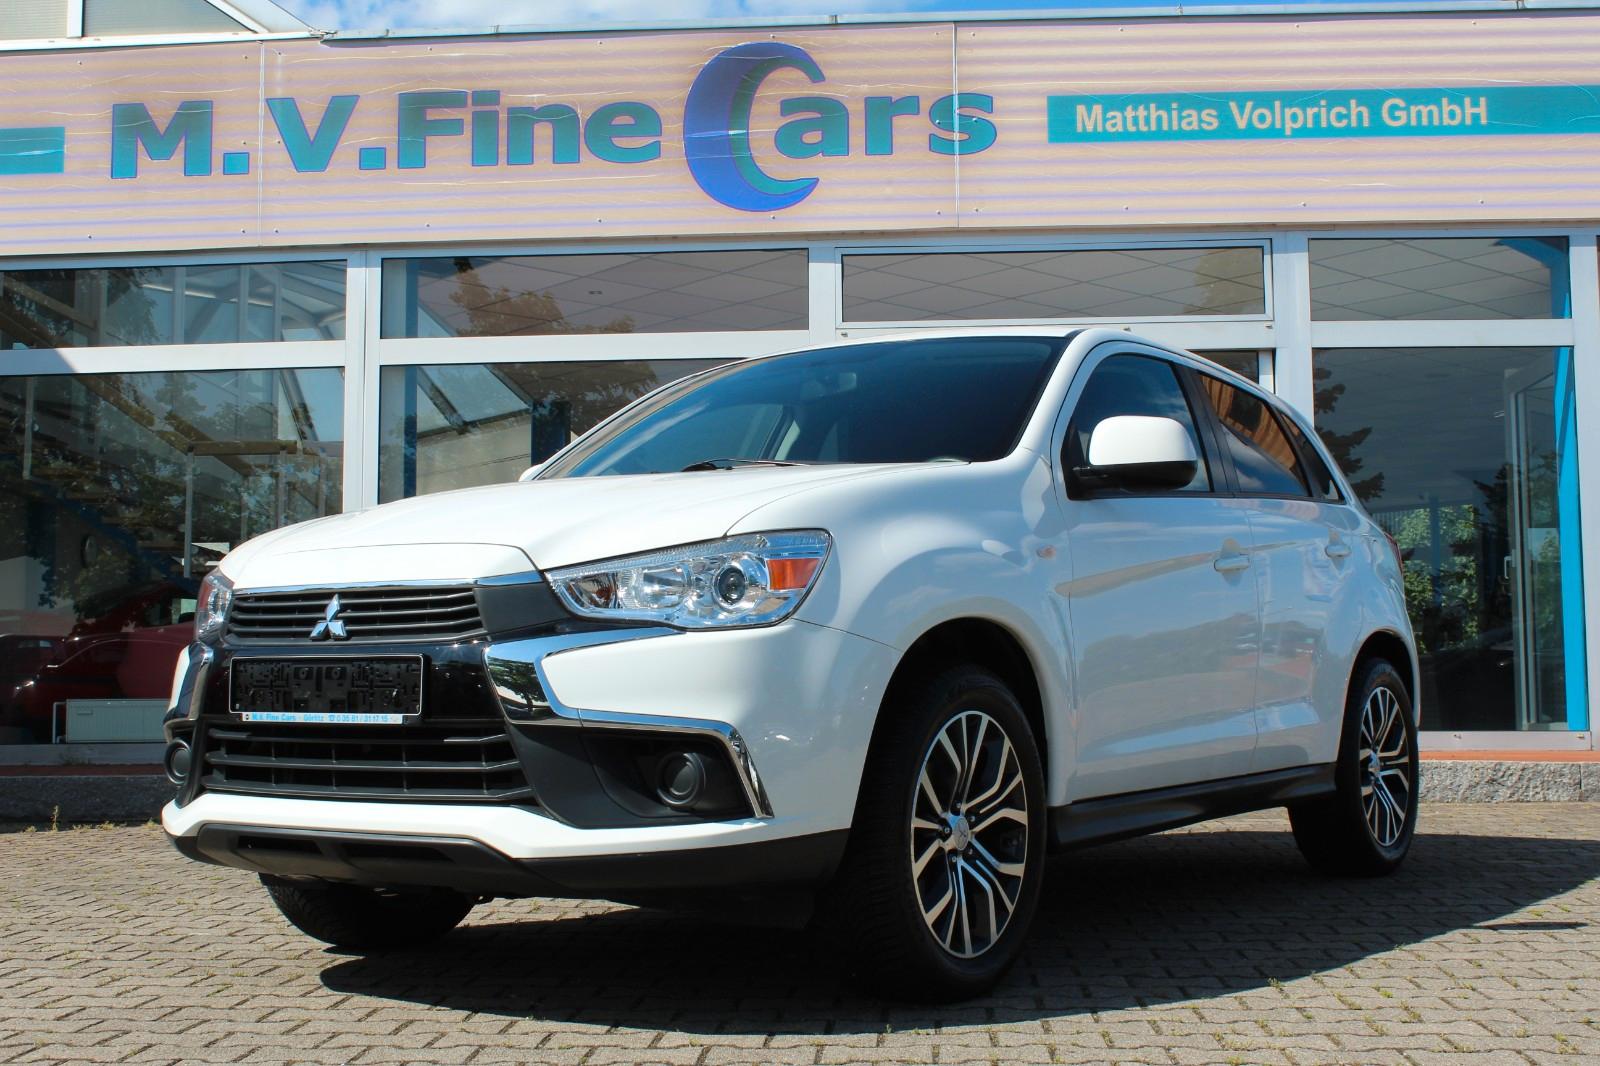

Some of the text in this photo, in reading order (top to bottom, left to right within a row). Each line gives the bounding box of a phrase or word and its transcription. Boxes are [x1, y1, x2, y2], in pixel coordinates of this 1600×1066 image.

[1075, 97, 1488, 135] Matthias Volprich GmbH
